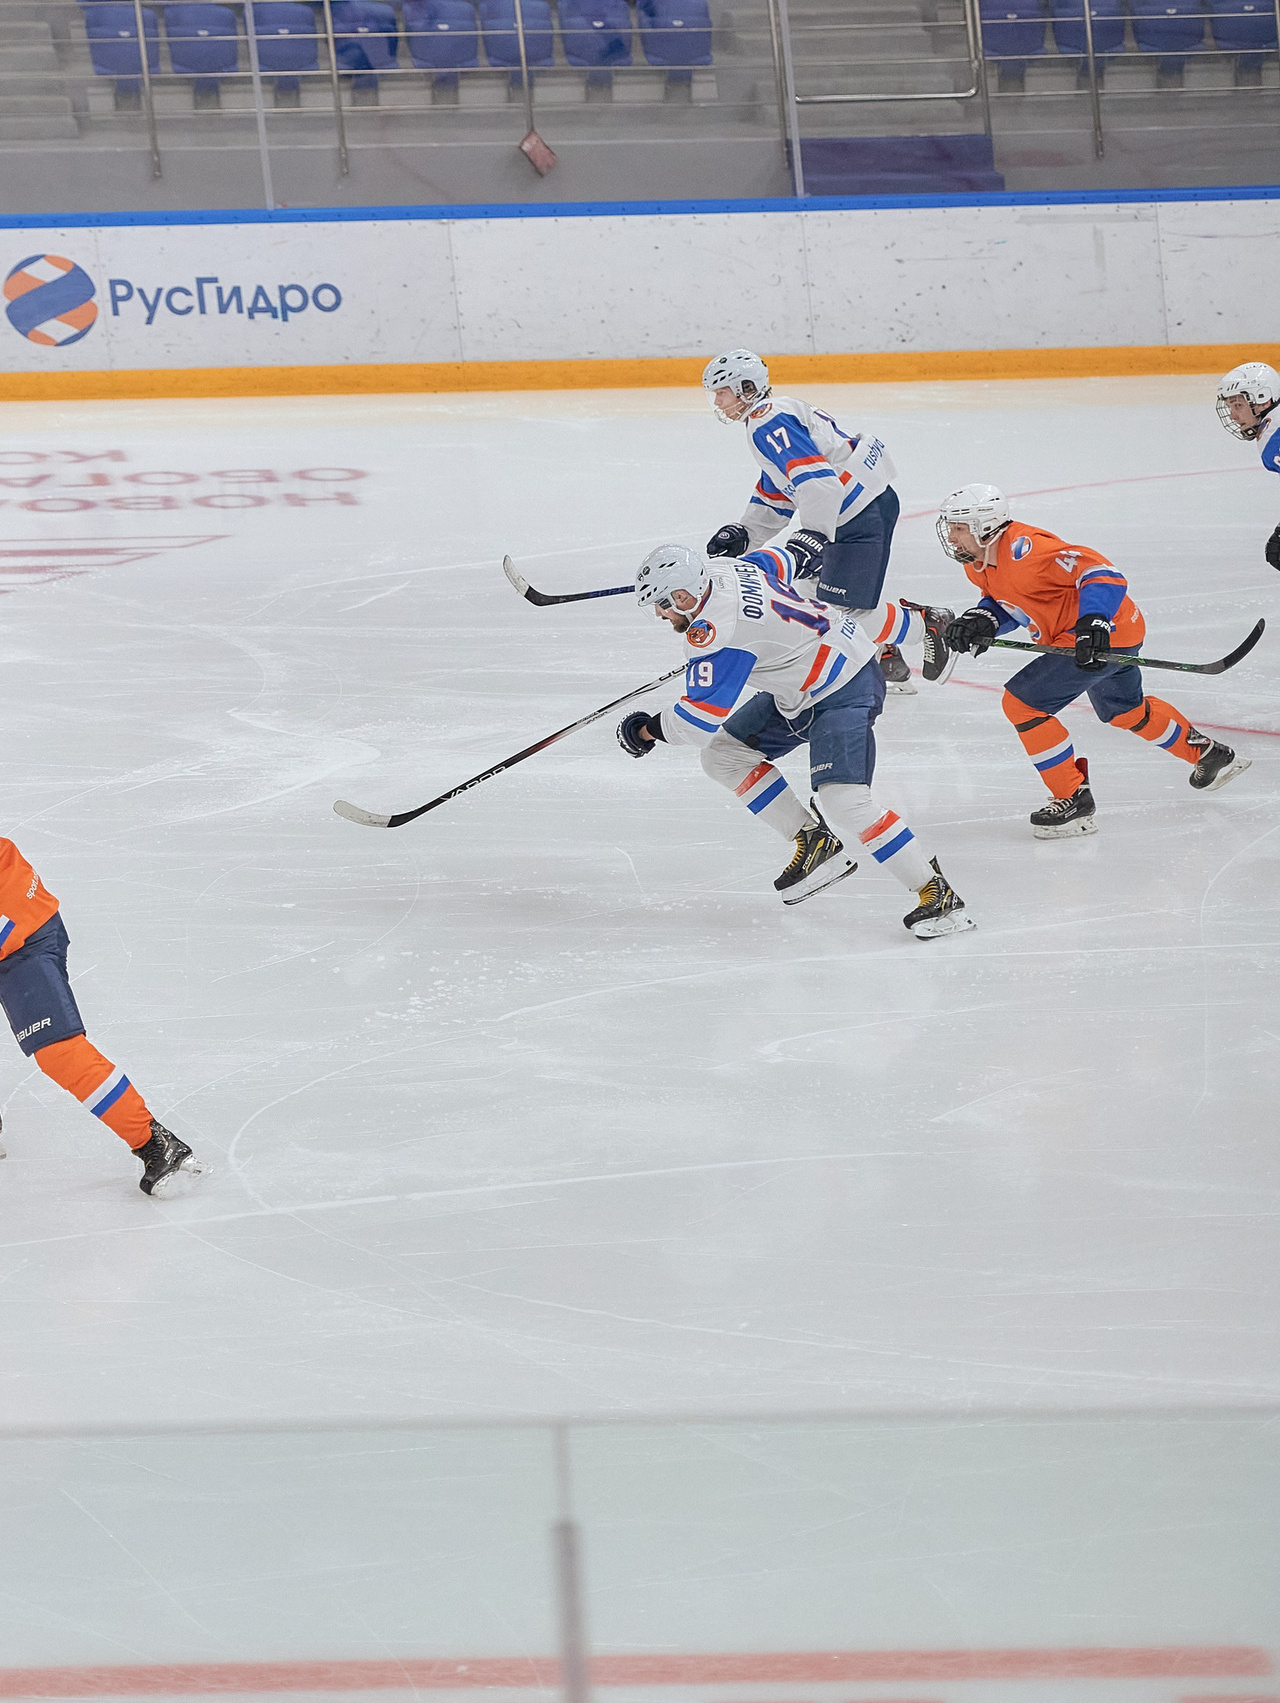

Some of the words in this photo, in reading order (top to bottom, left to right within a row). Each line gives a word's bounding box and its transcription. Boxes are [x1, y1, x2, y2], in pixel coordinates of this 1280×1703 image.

[108, 277, 343, 325] РусГидро
[765, 426, 791, 454] 17
[688, 661, 714, 687] 19
